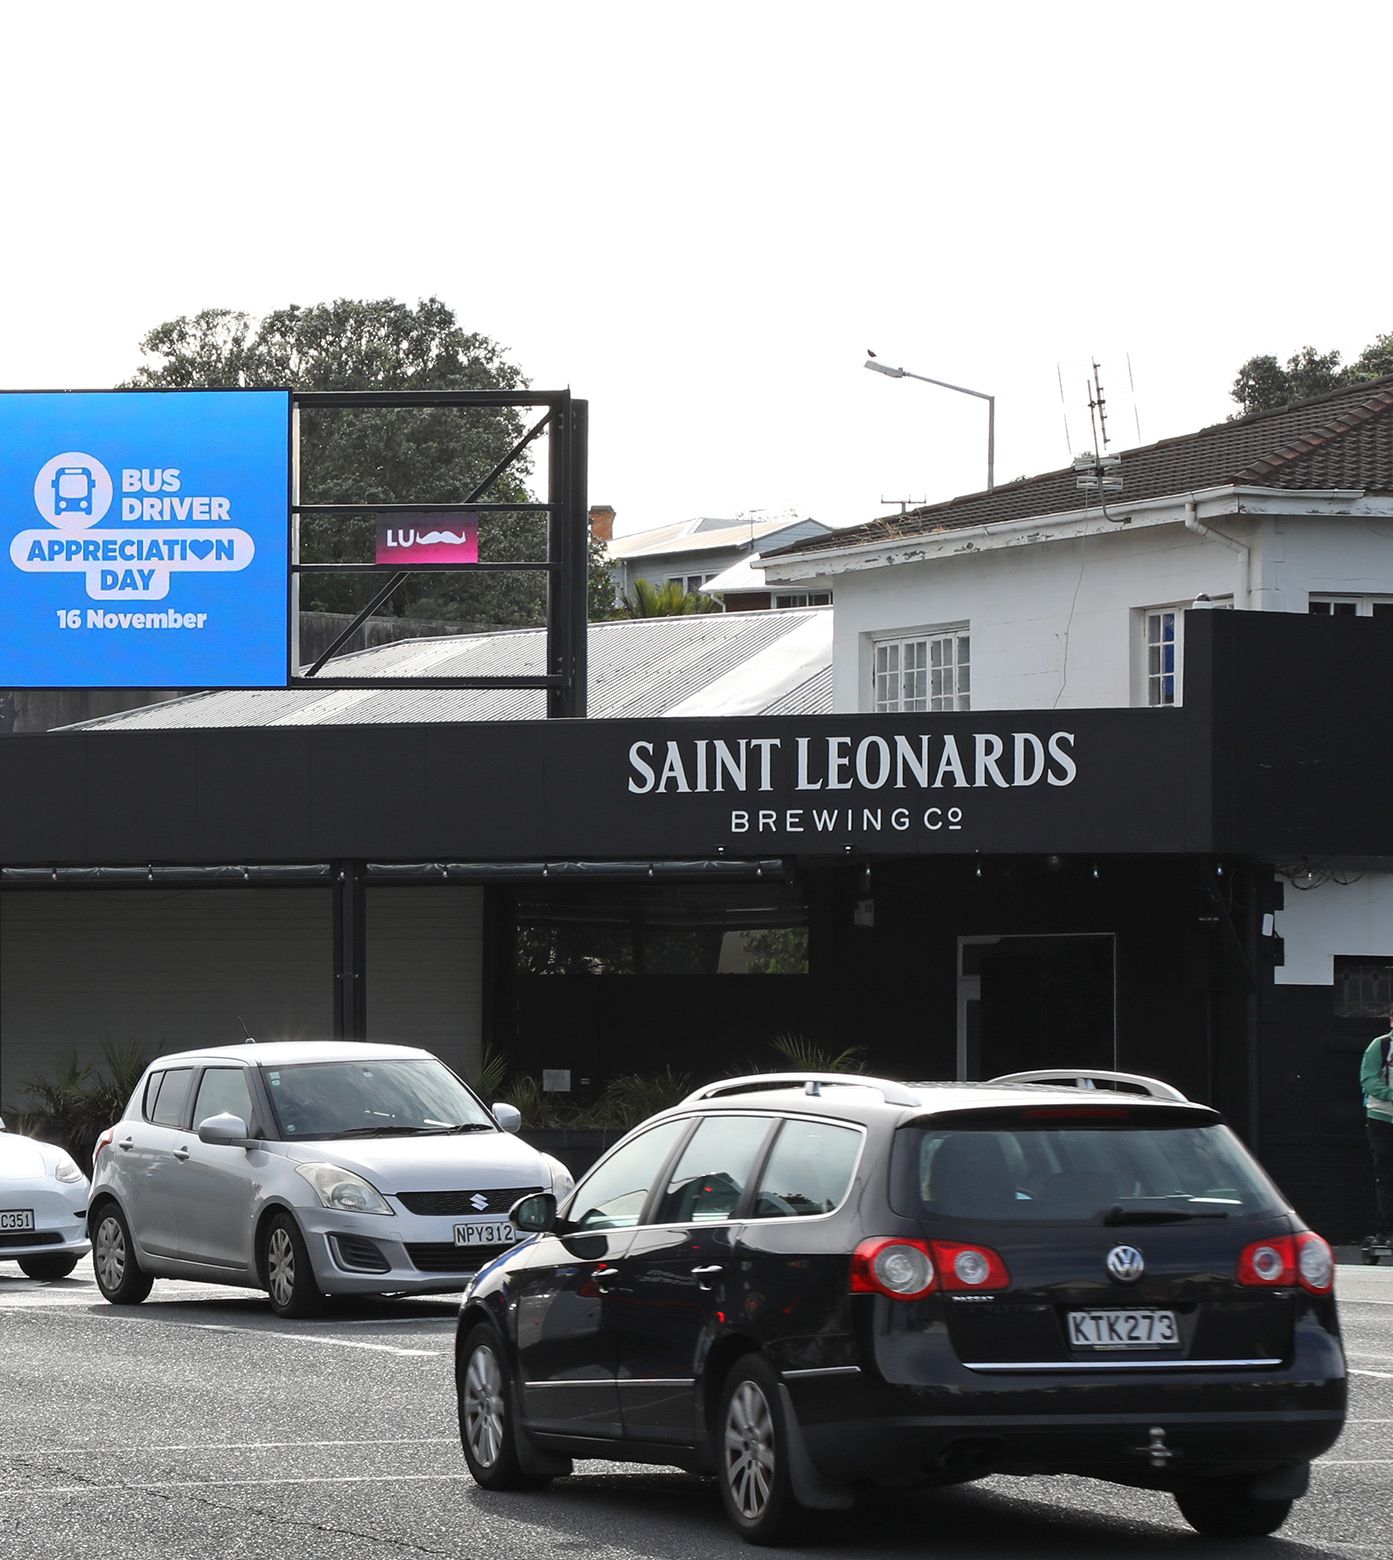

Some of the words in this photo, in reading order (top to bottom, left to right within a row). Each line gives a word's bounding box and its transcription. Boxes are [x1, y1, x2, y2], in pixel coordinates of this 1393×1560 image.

[121, 468, 182, 493] BUS
[121, 496, 231, 521] DRIVER
[100, 568, 155, 591] DAY
[56, 609, 83, 630] 16
[87, 607, 208, 630] November
[626, 737, 781, 795] SAINT
[794, 730, 1078, 791] LEONARDS
[730, 807, 910, 834] BREWING
[456, 1224, 513, 1243] NPY312
[1071, 1314, 1175, 1342] KTK273
